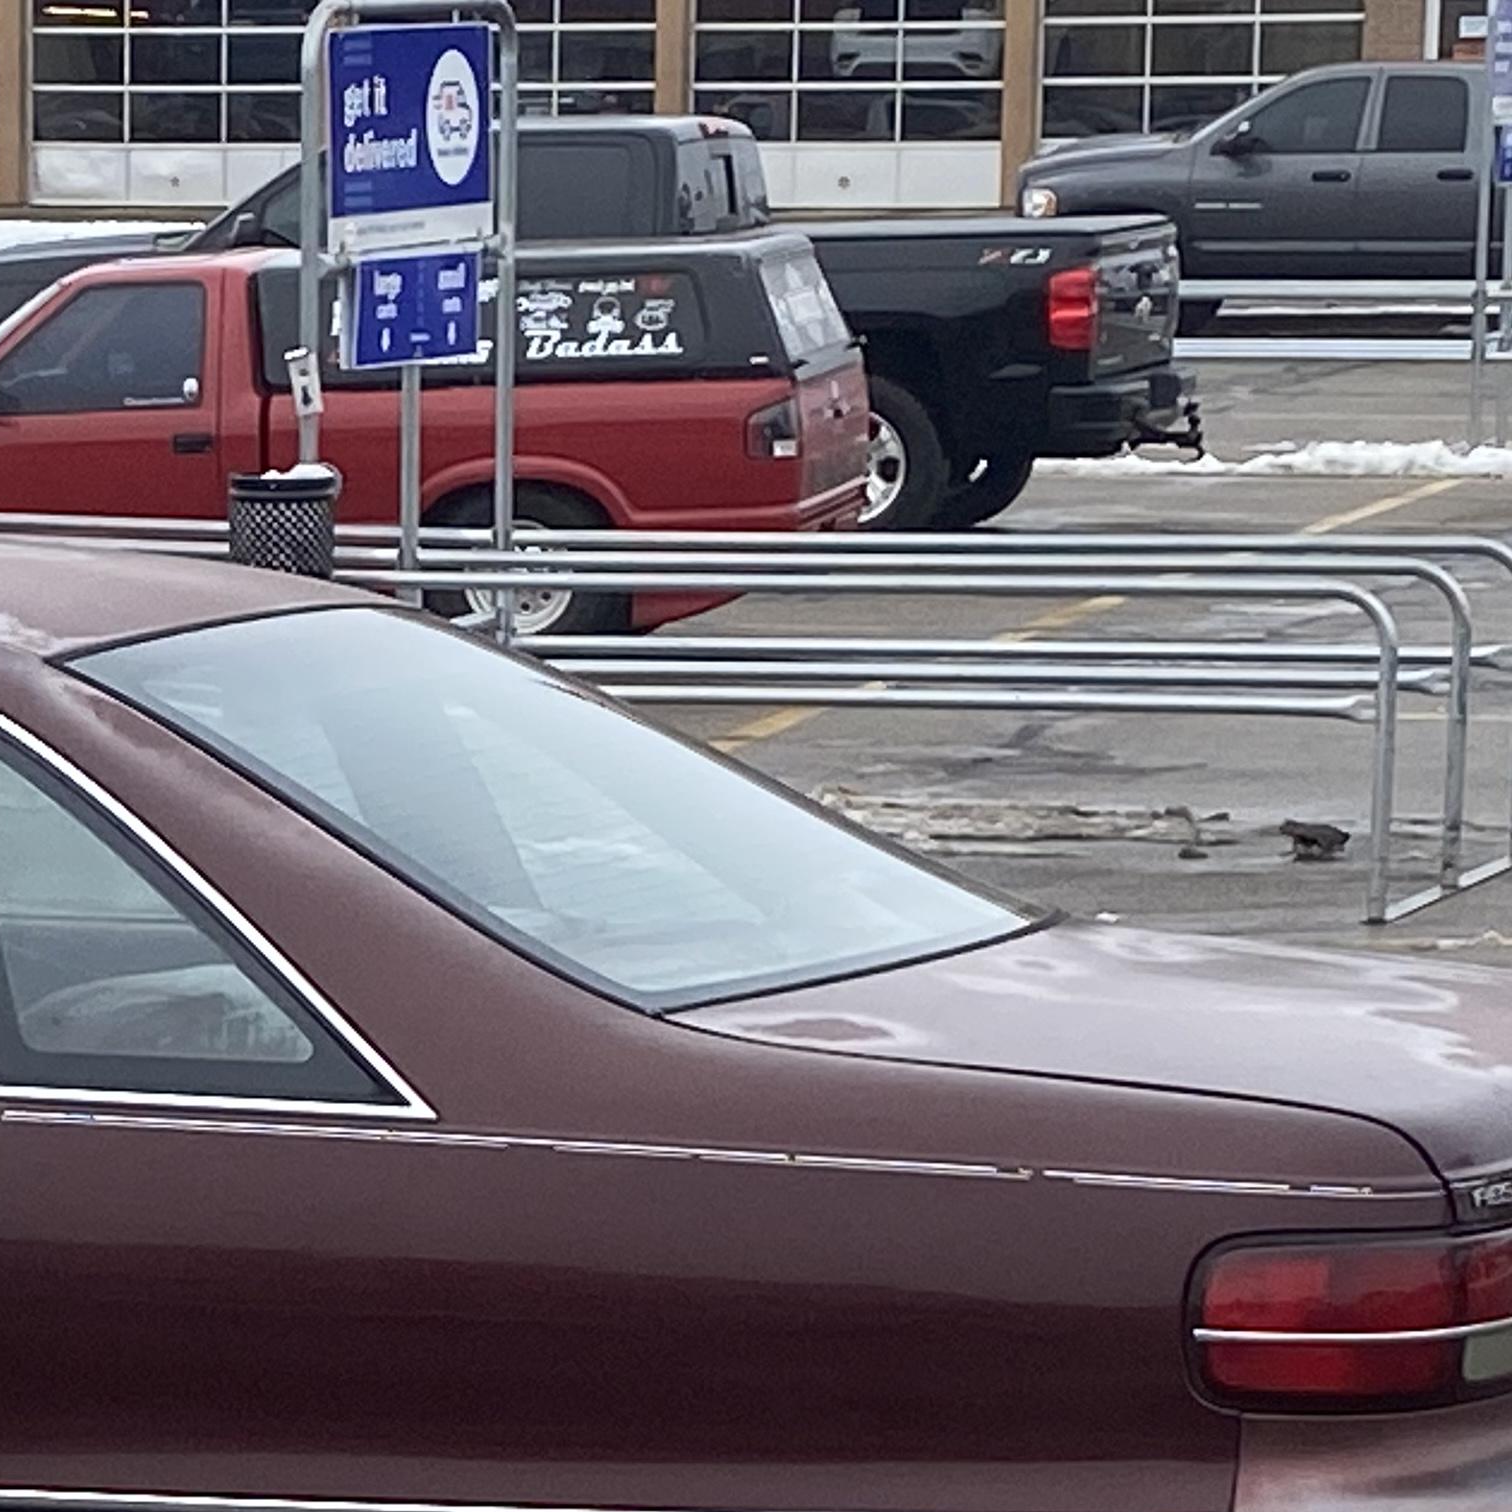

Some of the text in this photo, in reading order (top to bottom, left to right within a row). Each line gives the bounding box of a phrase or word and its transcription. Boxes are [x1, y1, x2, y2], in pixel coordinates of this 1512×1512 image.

[344, 74, 388, 127] get it
[344, 128, 418, 173] delivered
[524, 330, 683, 359] Badass
